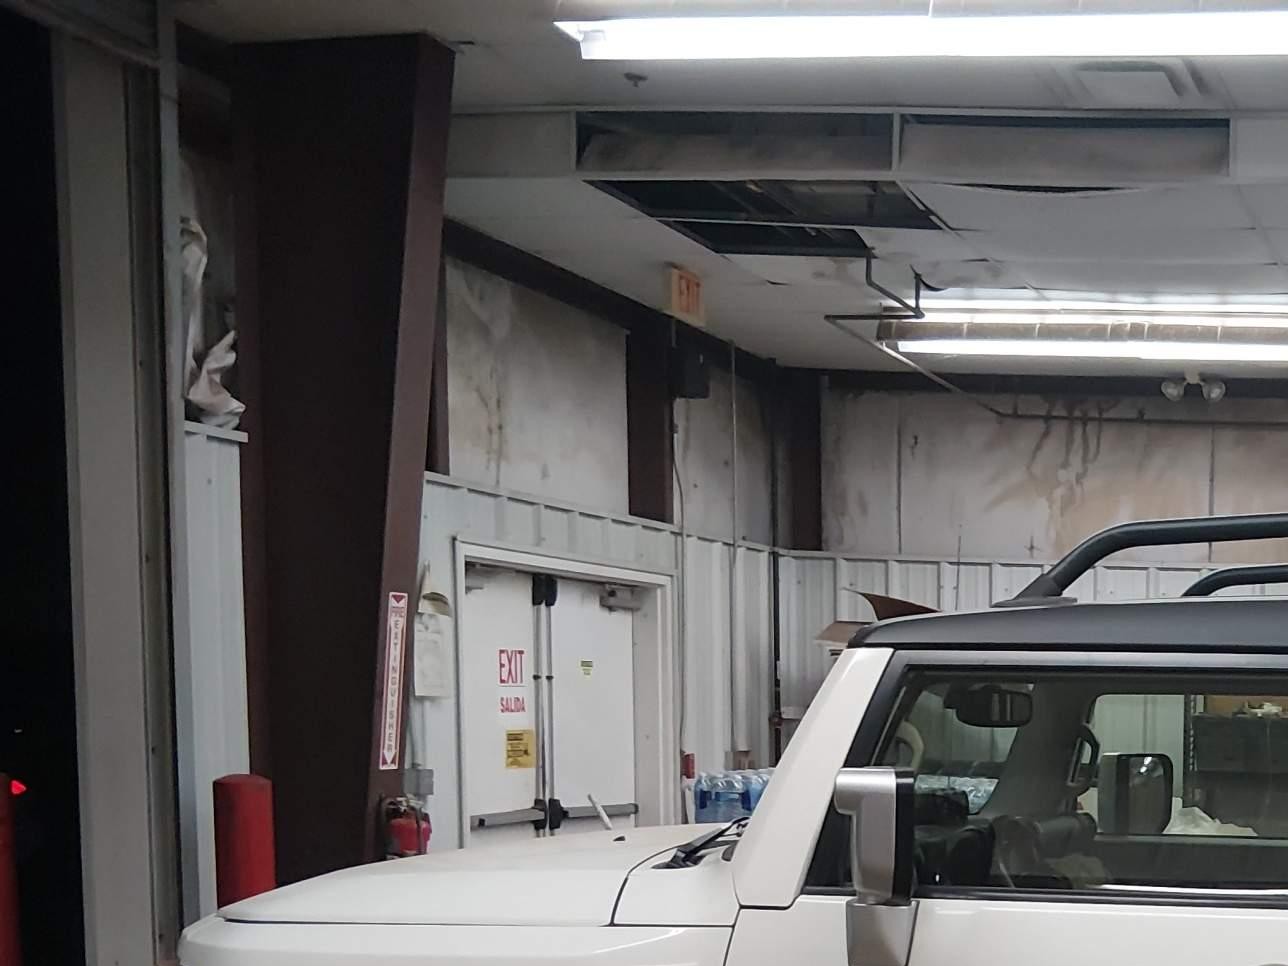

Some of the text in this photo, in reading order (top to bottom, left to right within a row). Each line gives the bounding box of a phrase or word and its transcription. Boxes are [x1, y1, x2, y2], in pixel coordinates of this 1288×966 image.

[679, 272, 701, 314] EXIT
[499, 649, 525, 684] EXIT
[500, 696, 526, 713] SALIDA
